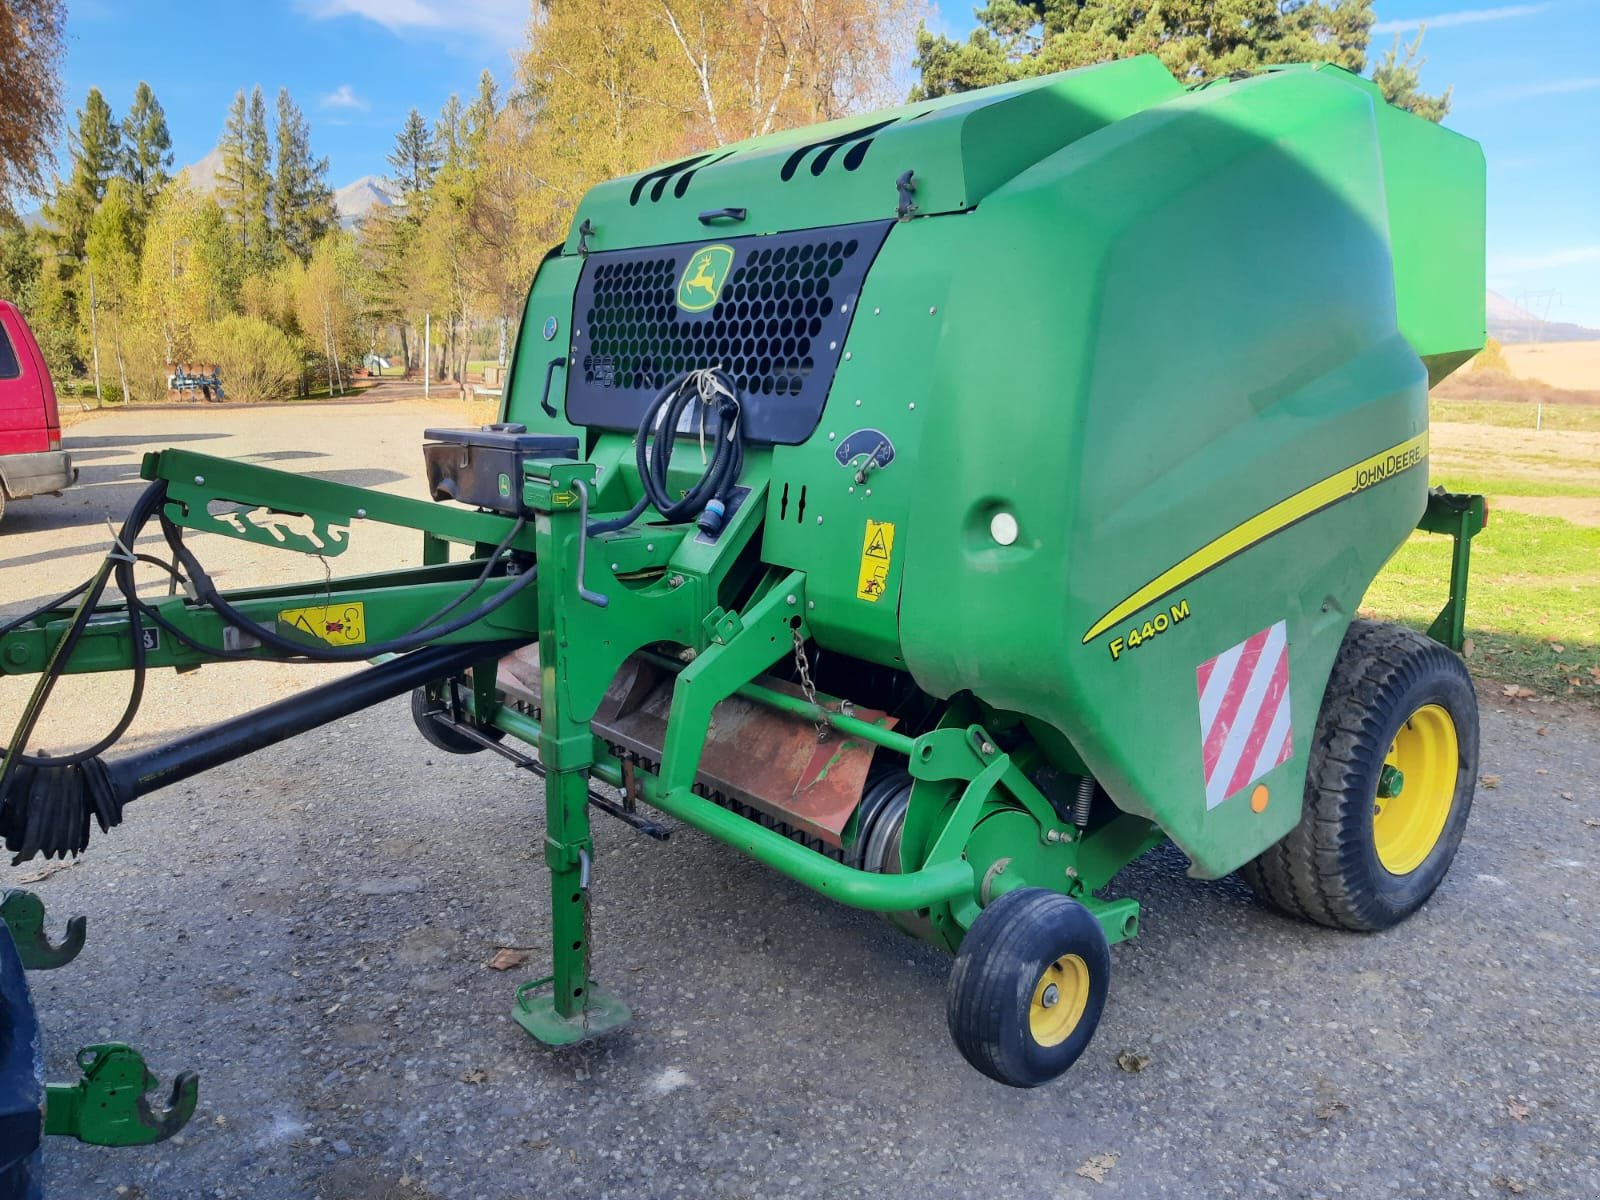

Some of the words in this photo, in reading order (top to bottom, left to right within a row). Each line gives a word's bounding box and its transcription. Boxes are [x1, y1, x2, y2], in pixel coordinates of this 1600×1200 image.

[1352, 461, 1385, 491] JOHN
[1386, 446, 1421, 475] DEERE
[1109, 636, 1124, 660] F
[1127, 613, 1169, 650] 440
[1169, 598, 1191, 625] M
